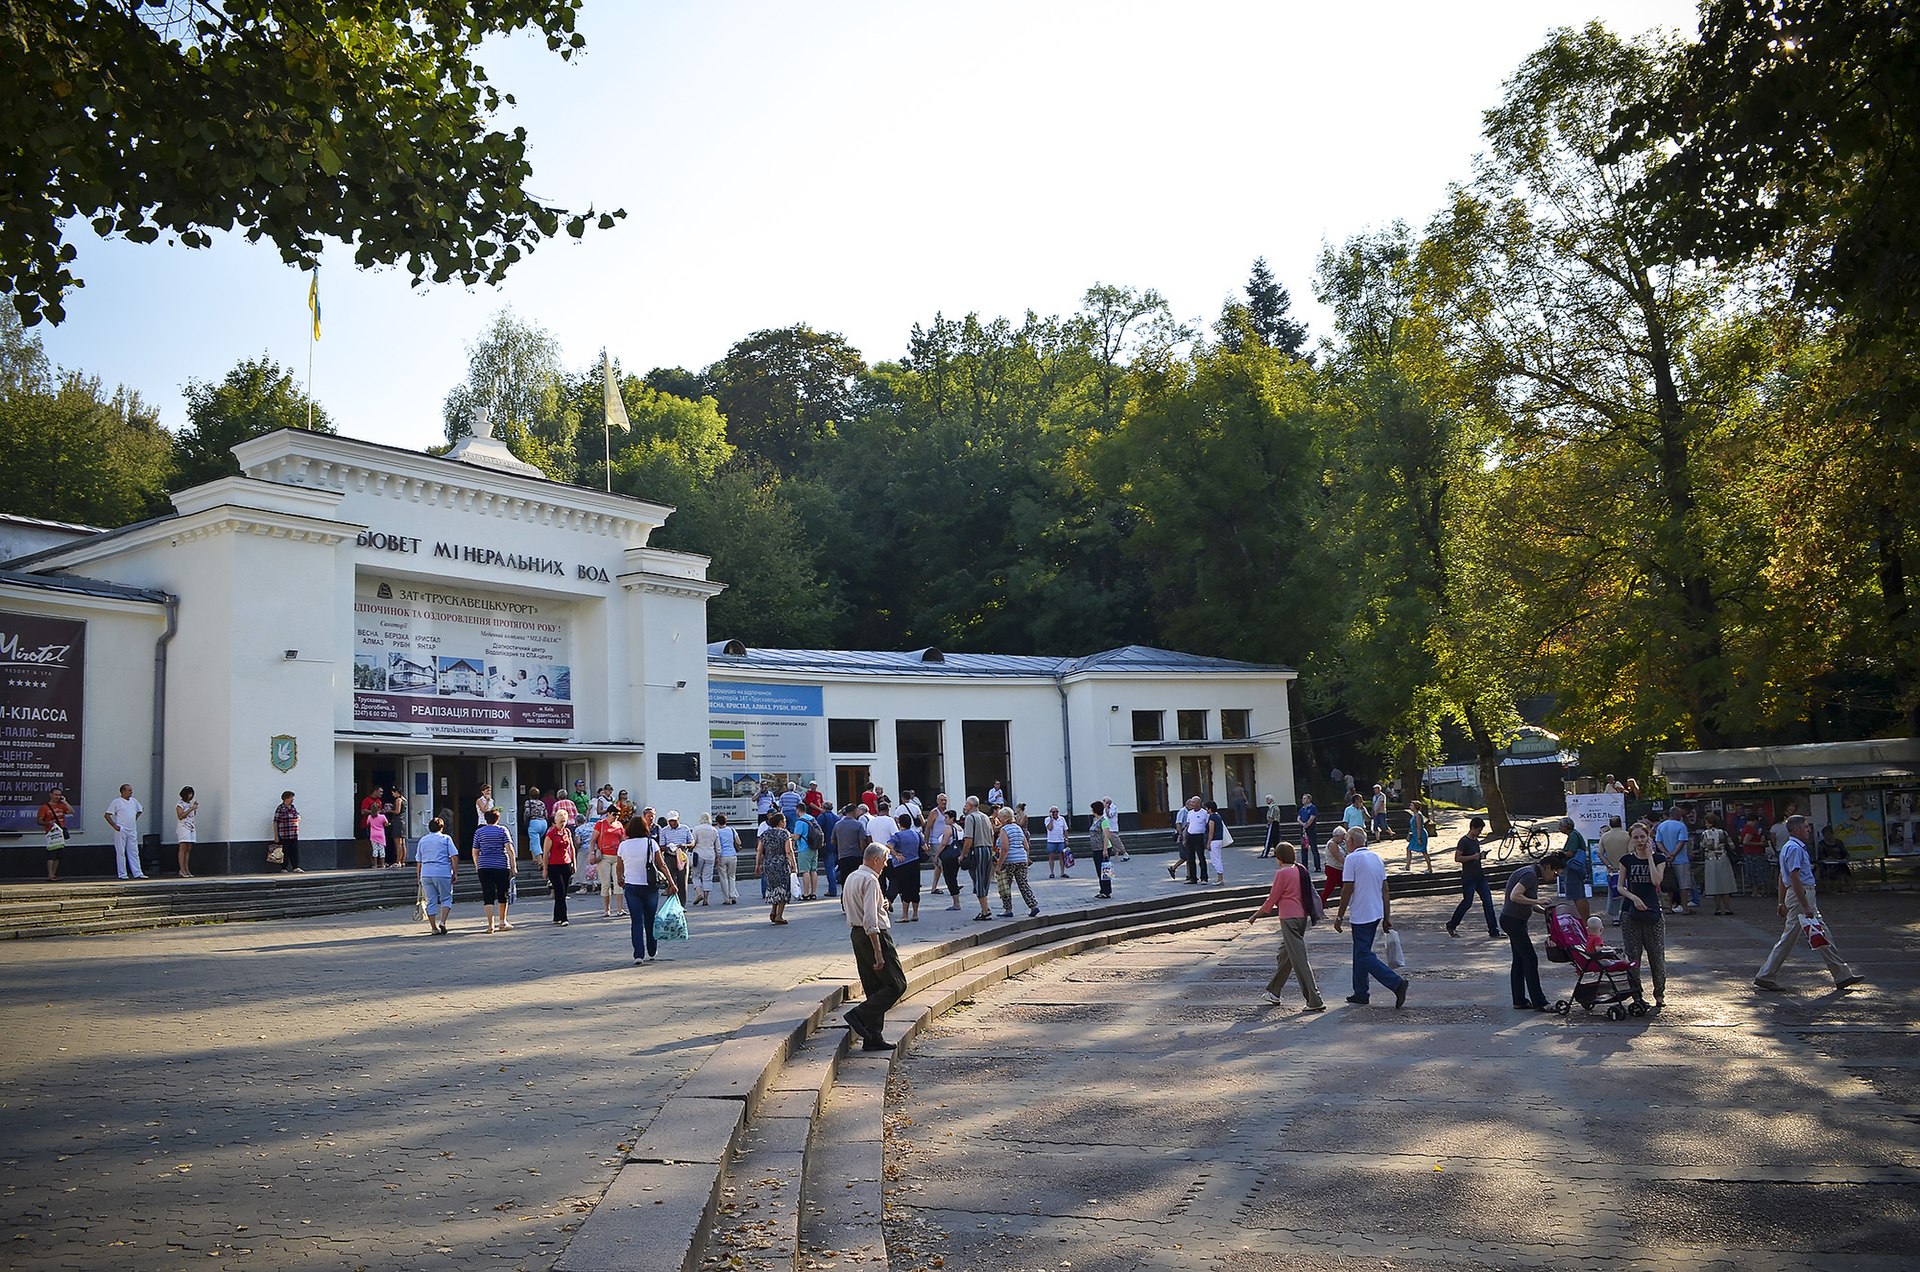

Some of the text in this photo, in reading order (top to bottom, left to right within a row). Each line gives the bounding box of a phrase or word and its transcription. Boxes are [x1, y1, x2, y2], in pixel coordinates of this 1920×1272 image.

[356, 530, 422, 554] БЮВЕТ
[577, 564, 610, 583] ВОД
[400, 590, 538, 614] ЗАТ «ТРУСКАВЕЦЬКУРОРТ»
[354, 603, 410, 617] ІДПОЧИНОК
[412, 610, 422, 618] ТА
[424, 610, 490, 626] ОЗДОРОВЛЕННЯ
[493, 618, 535, 630] ПРОТЯГОМ
[538, 624, 556, 632] РОКУ
[358, 629, 441, 644] ВЕСНА БЕРІЗКА КРИСТАЛ
[362, 638, 384, 646] АЛМАЗ
[411, 705, 510, 720] РЕАЛІЗАЦІЯ ПУТІВОК
[0, 726, 38, 738] -ПАЛАС
[0, 750, 34, 762] -ЦЕНТР
[0, 782, 12, 792] ЛА
